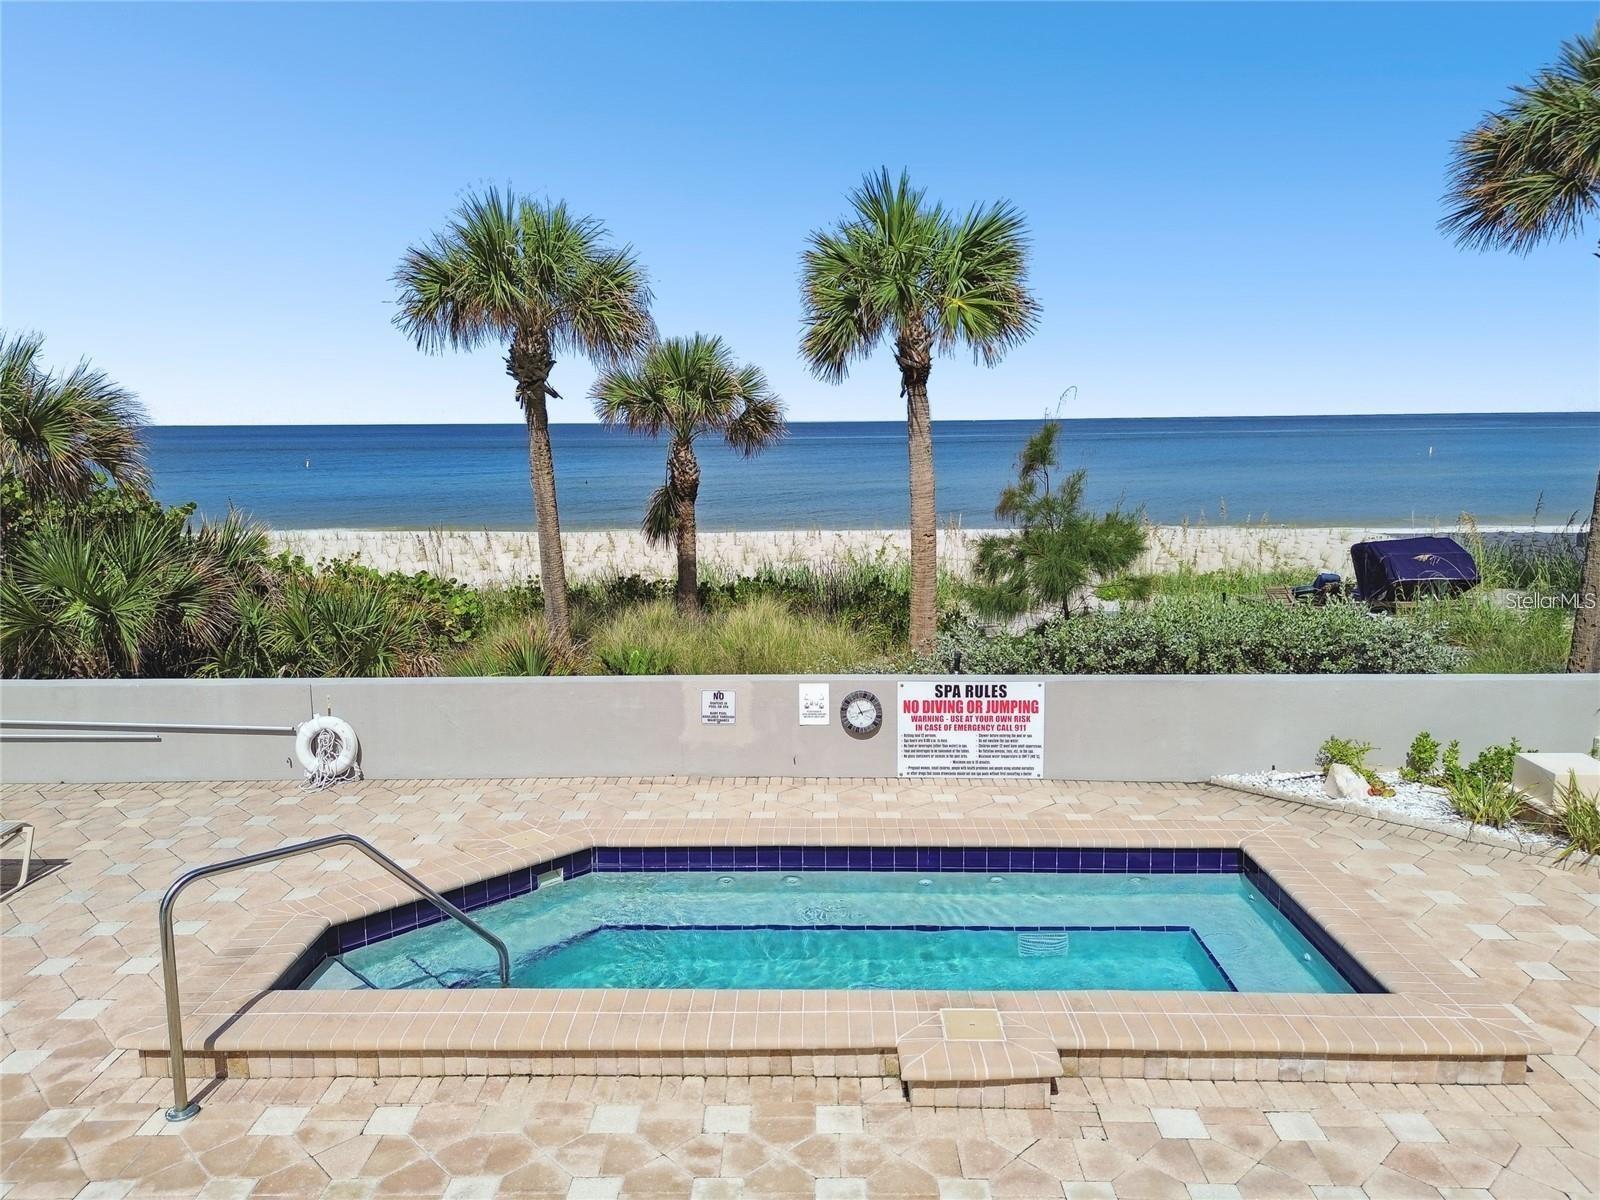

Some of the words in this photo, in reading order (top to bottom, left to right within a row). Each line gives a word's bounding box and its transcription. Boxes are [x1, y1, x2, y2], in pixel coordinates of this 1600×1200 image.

[713, 692, 724, 700] NO
[934, 684, 961, 698] SPA
[965, 684, 1008, 698] RULES
[903, 700, 919, 714] NO
[922, 700, 964, 714] DIVING
[966, 700, 983, 714] OR
[986, 700, 1040, 714] JUMPING
[915, 724, 922, 732] IN
[924, 724, 942, 732] CASE
[944, 724, 952, 732] OF
[954, 724, 995, 732] EMERGENCY
[996, 724, 1013, 732] CALL
[1014, 724, 1026, 732] 911
